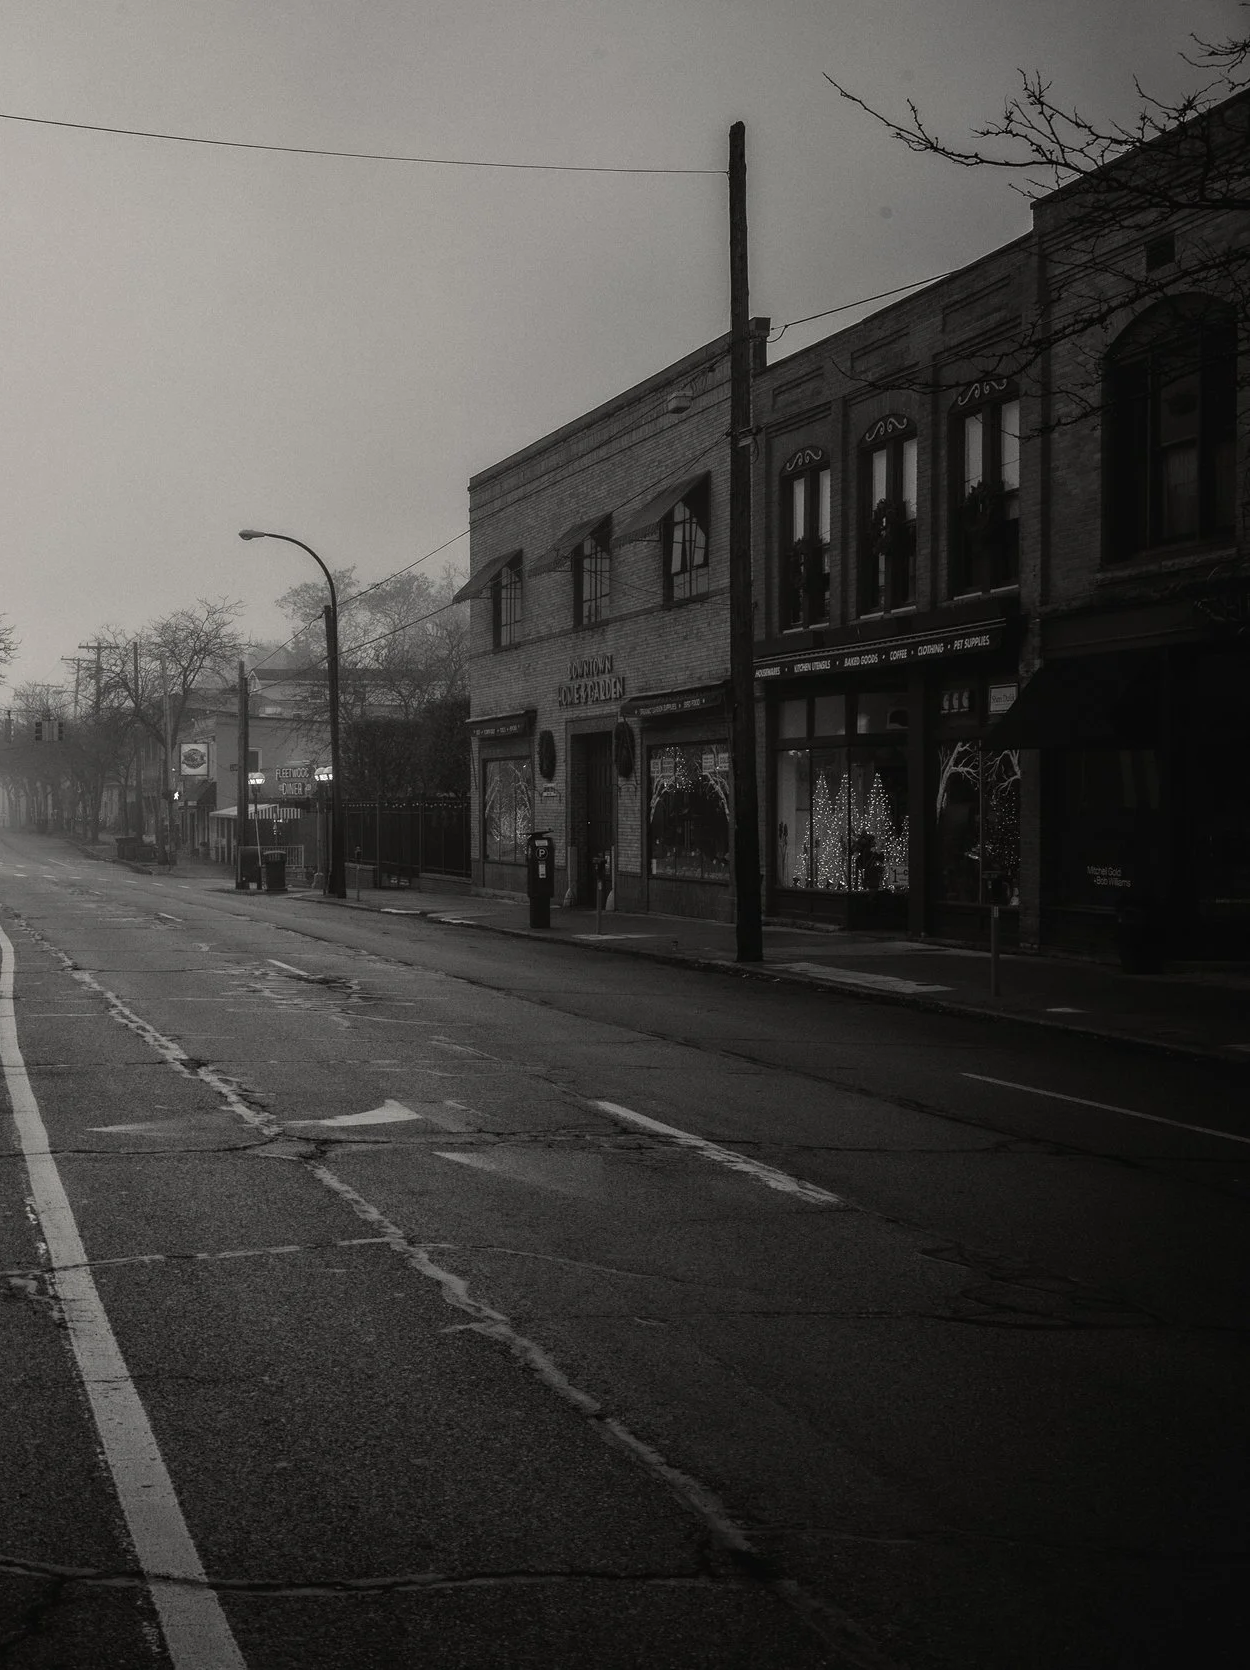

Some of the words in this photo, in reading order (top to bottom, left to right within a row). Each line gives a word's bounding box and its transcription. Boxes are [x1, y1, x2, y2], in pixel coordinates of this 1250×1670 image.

[844, 656, 860, 667] BAKED
[860, 653, 878, 665] GOODS
[889, 649, 908, 661] COFFEE
[917, 643, 945, 656] CLOTHING
[953, 639, 964, 650] PET
[964, 635, 990, 649] SUPPLIES
[567, 655, 613, 678] DOWNTOWN
[588, 677, 626, 704] GARDEN
[282, 782, 303, 796] DINER
[1108, 866, 1122, 877] Gold
